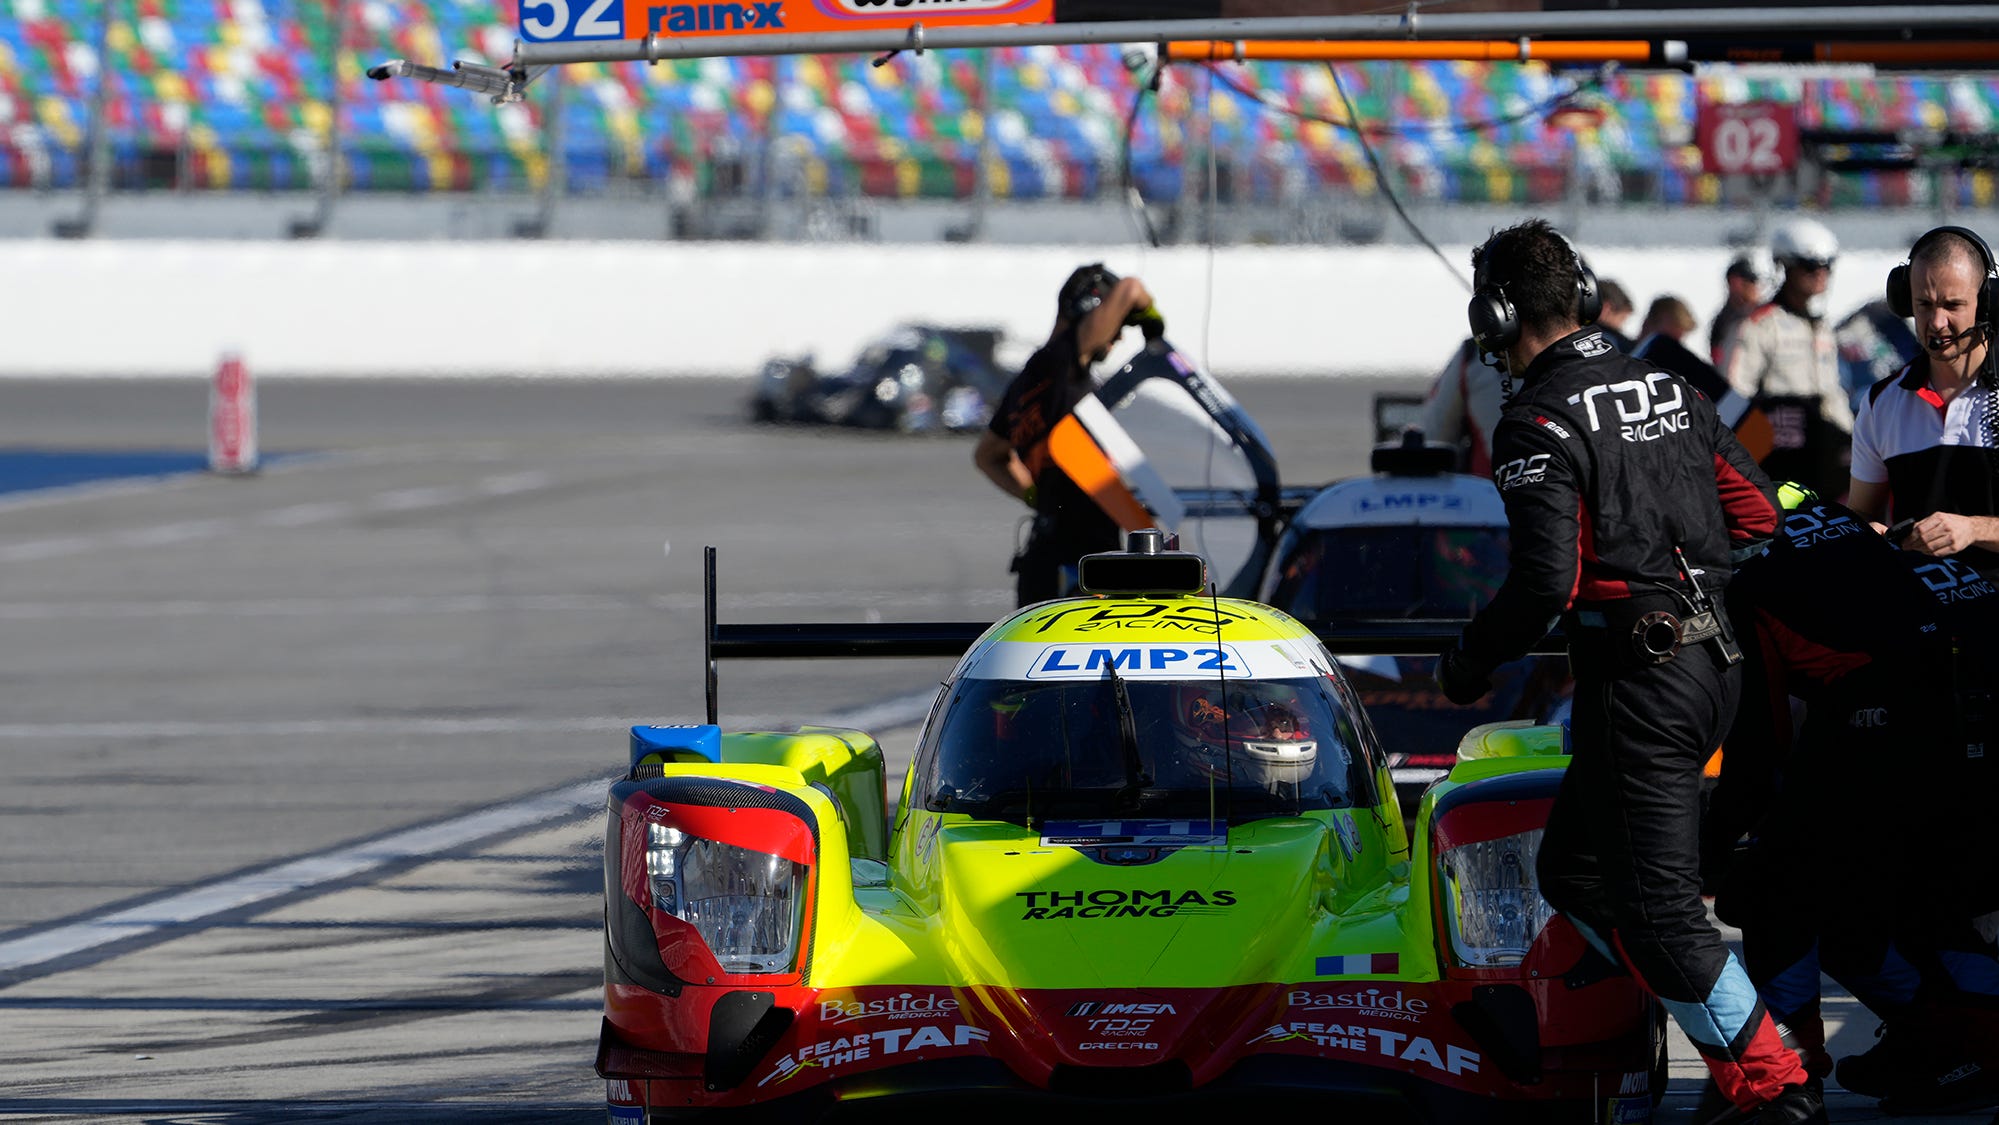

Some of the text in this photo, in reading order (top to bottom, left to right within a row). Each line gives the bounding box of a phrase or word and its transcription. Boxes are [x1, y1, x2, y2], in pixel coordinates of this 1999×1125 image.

[522, 0, 621, 40] 52
[1713, 118, 1783, 171] 02
[1567, 372, 1682, 431] TDS
[1495, 454, 1551, 487] TDS
[1936, 580, 1997, 604] RACING
[1030, 604, 1250, 634] TDS
[1074, 620, 1222, 635] RACING
[1041, 648, 1237, 671] LMP2
[1016, 889, 1237, 907] THOMAS
[1021, 905, 1180, 920] RACING
[820, 993, 960, 1021] Bastide
[1101, 1003, 1177, 1015] IMSA
[1288, 988, 1429, 1015] Bastide
[1088, 1019, 1155, 1031] TDS
[1290, 1022, 1366, 1037] FEAR
[798, 1033, 870, 1061] FEAR
[872, 1025, 991, 1055] TAF
[1312, 1035, 1367, 1051] THE
[1368, 1027, 1480, 1076] TAF
[818, 1046, 870, 1069] THE
